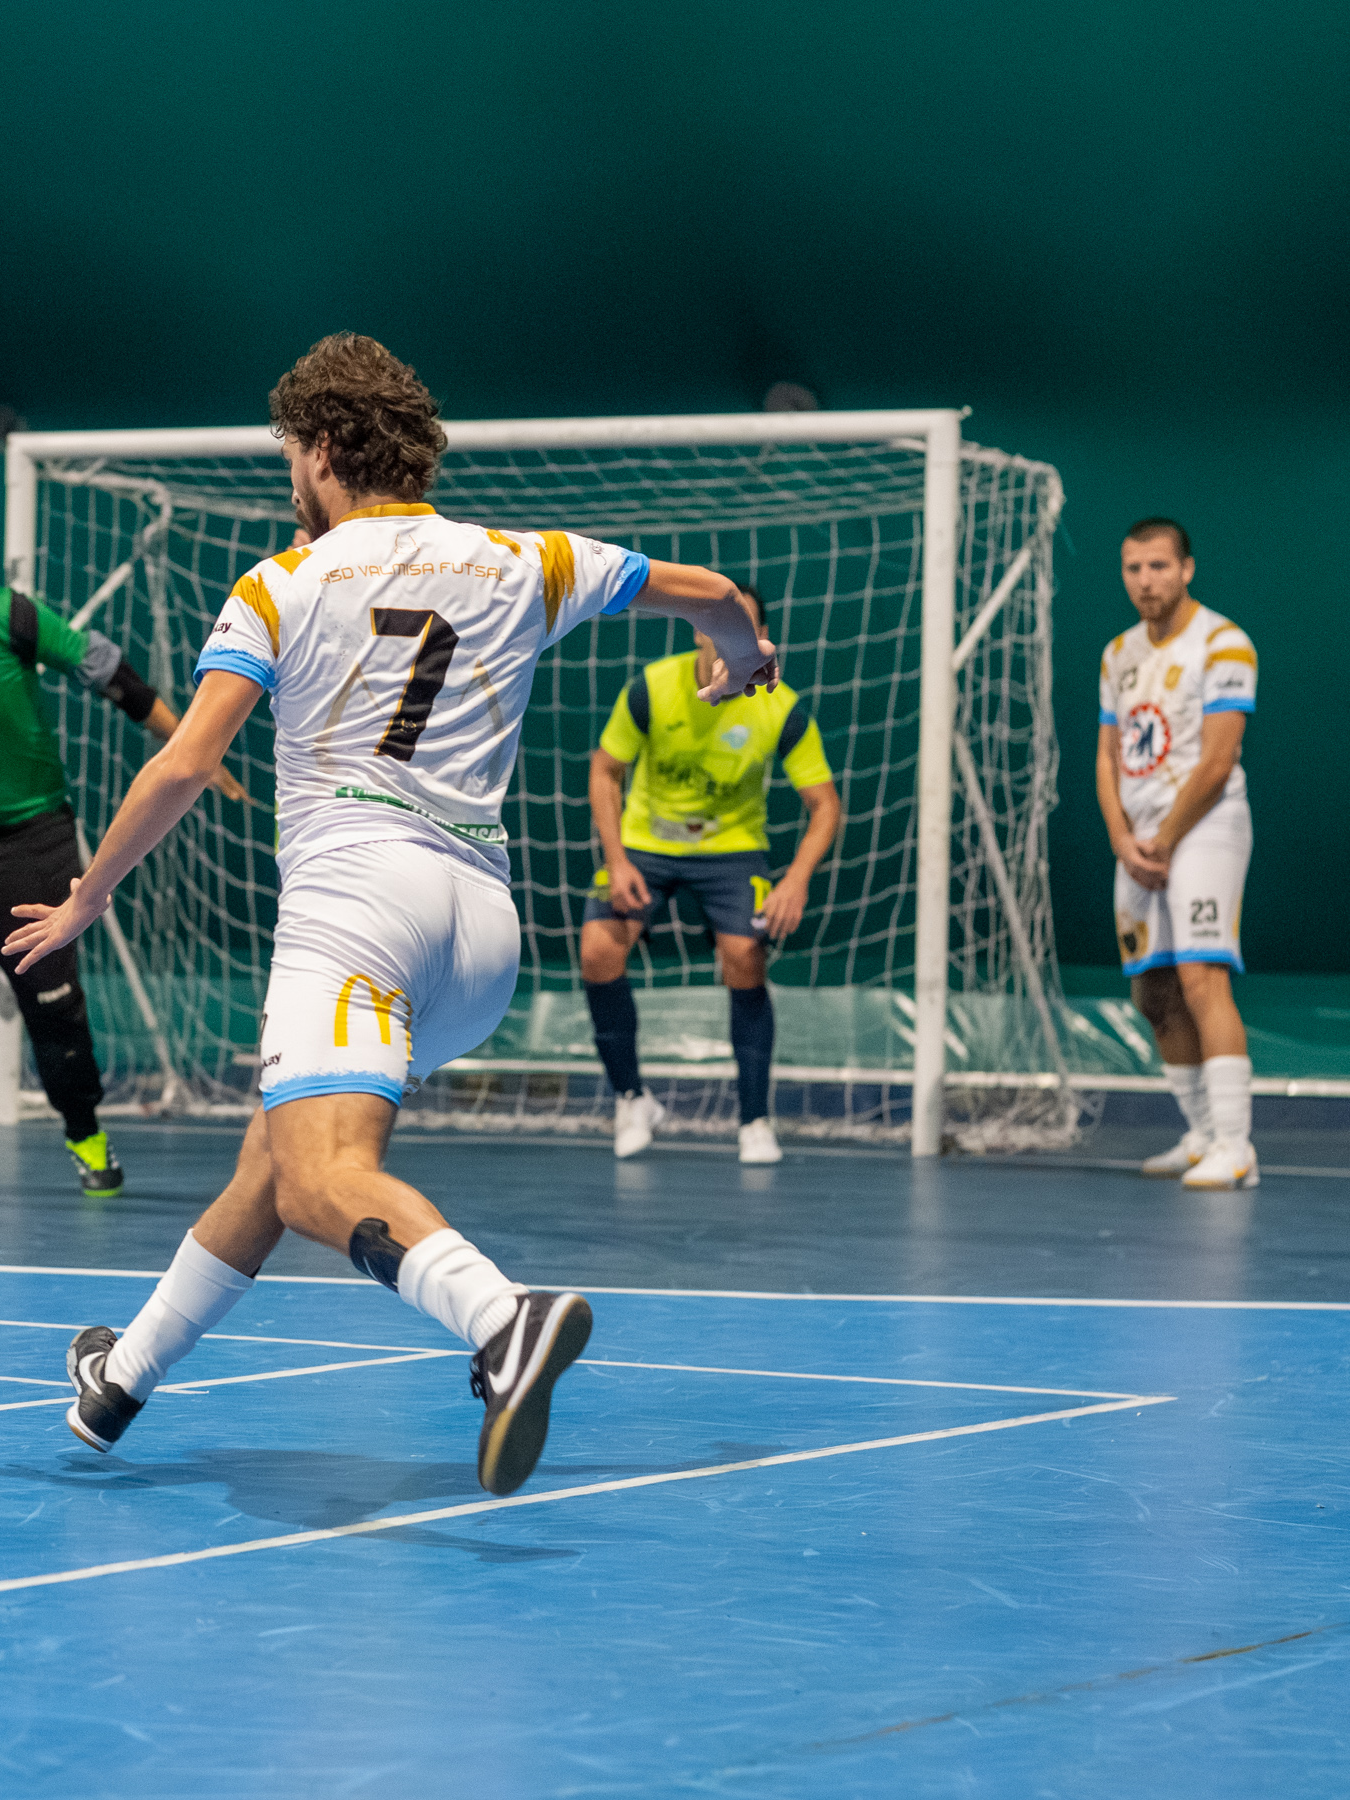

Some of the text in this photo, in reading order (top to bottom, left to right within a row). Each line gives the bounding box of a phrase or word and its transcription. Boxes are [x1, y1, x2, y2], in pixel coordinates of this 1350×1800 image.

[320, 561, 507, 584] ASD VALMISA FUTSAL
[370, 607, 460, 762] 7
